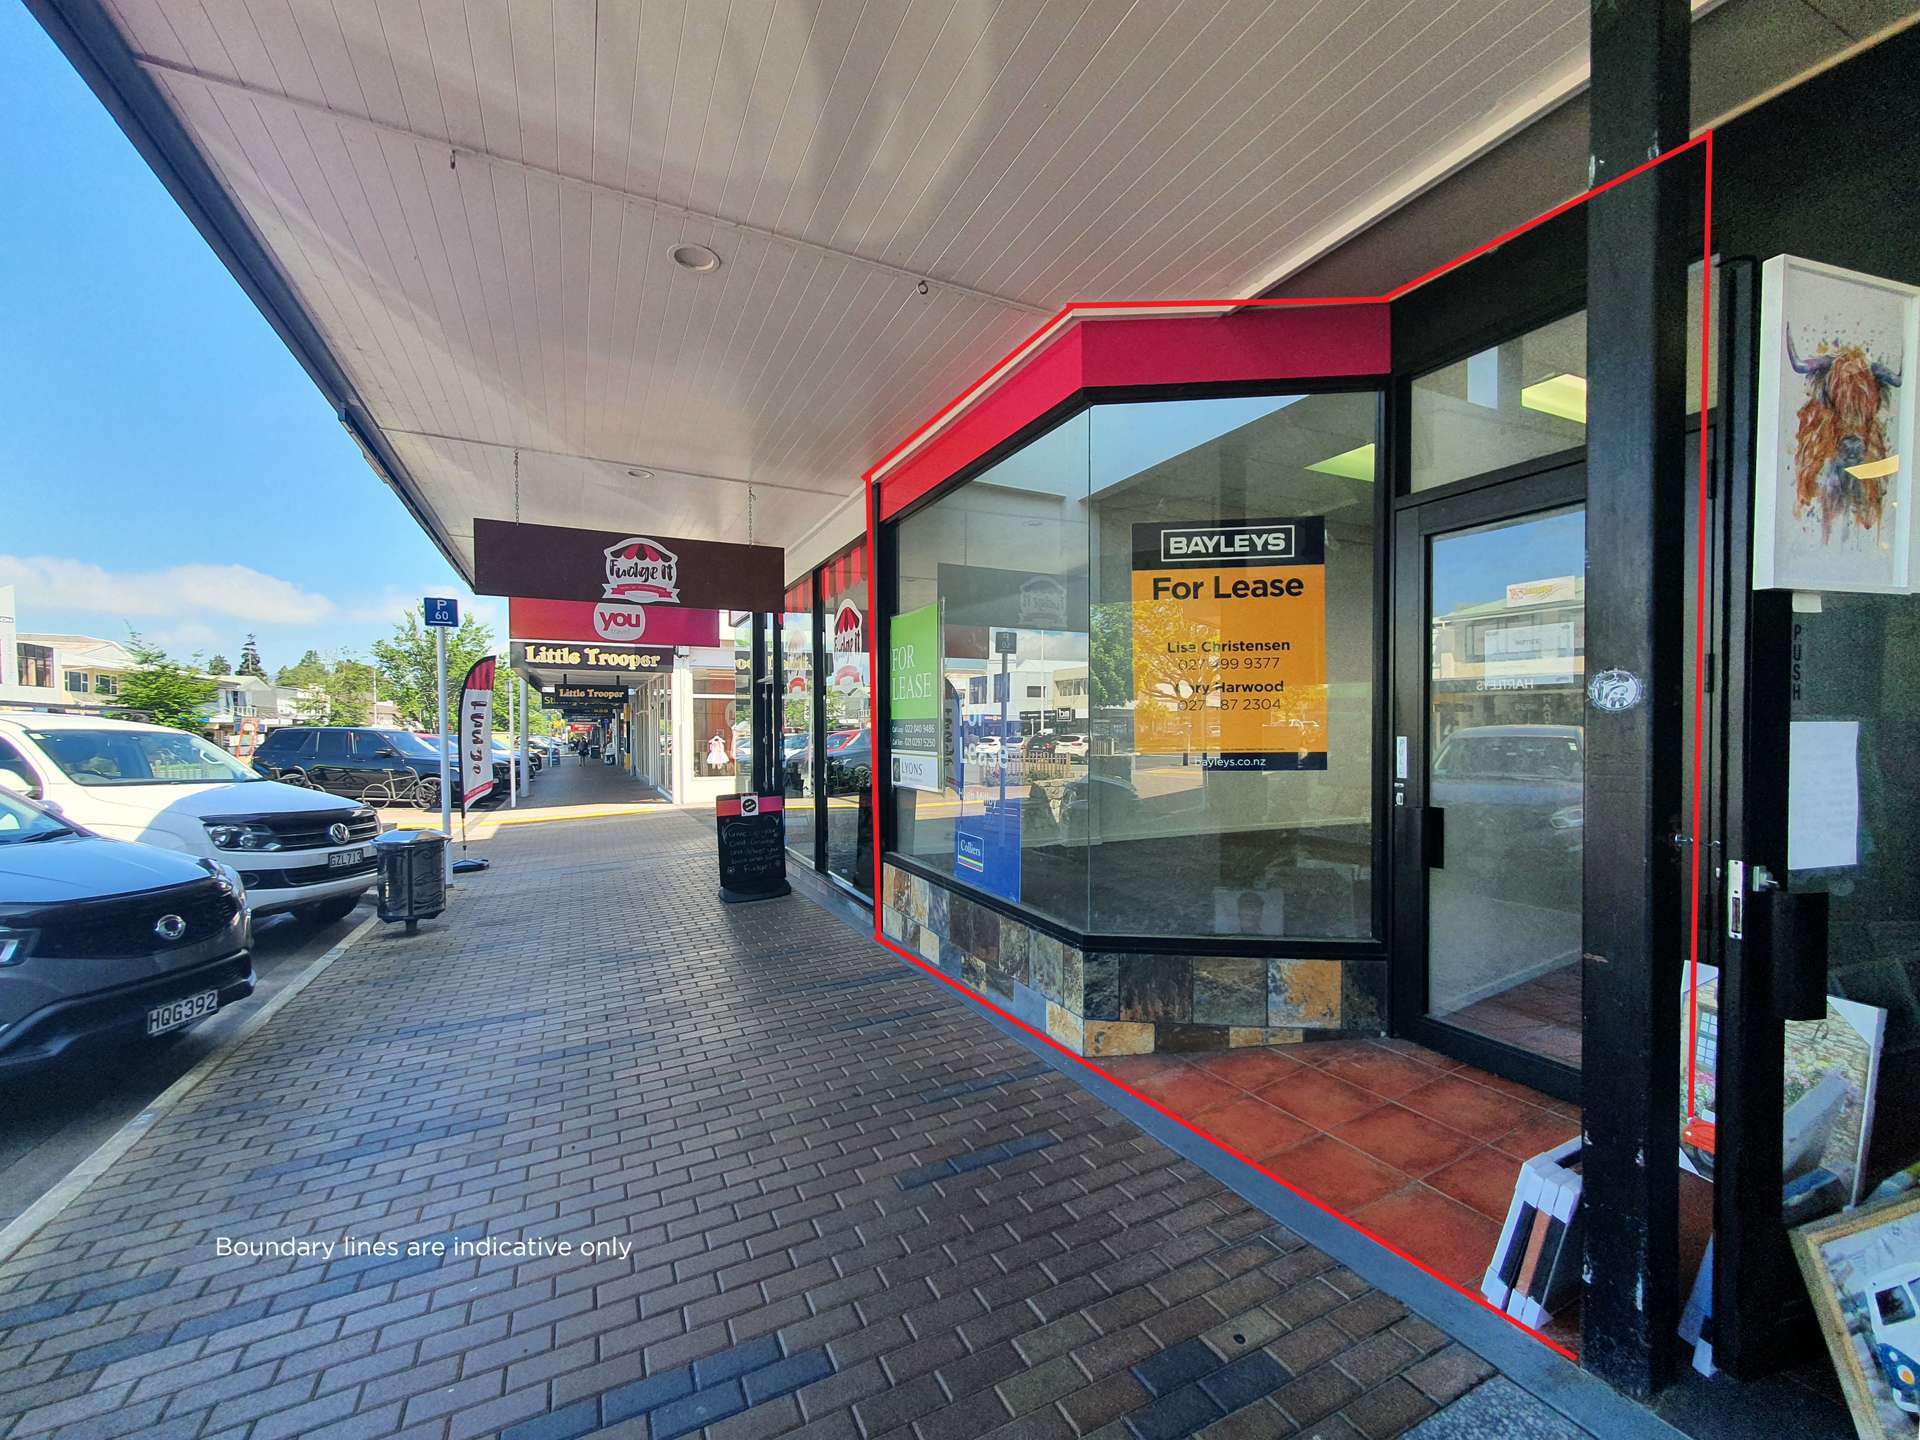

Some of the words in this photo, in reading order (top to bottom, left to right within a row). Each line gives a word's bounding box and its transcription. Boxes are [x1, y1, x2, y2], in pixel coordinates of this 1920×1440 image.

[1169, 533, 1285, 554] BAYLEYS
[609, 559, 658, 583] Fudge
[1153, 577, 1204, 600] For
[1214, 575, 1304, 599] Lease
[437, 600, 447, 610] P
[435, 611, 448, 620] 60
[599, 611, 641, 631] you
[1168, 642, 1196, 653] Lisa
[1201, 640, 1290, 653] Christensen
[525, 645, 581, 665] Little
[584, 647, 660, 670] Trooper
[891, 644, 915, 672] FOR
[1178, 657, 1205, 671] 027
[1208, 657, 1239, 670] 99
[1243, 656, 1280, 669] 9377
[1793, 624, 1802, 700] PUSH
[559, 688, 585, 698] Little
[587, 689, 624, 699] Trooper
[892, 672, 932, 701] LEASE
[1215, 680, 1284, 693] Harwood
[1178, 699, 1205, 711] 027
[1207, 698, 1238, 711] 87
[1242, 698, 1281, 710] 2304
[960, 736, 1008, 769] Lease
[901, 761, 923, 776] LYONS
[960, 839, 981, 857] Colliers
[330, 850, 362, 866] GZL713
[149, 992, 216, 1032] HQG392
